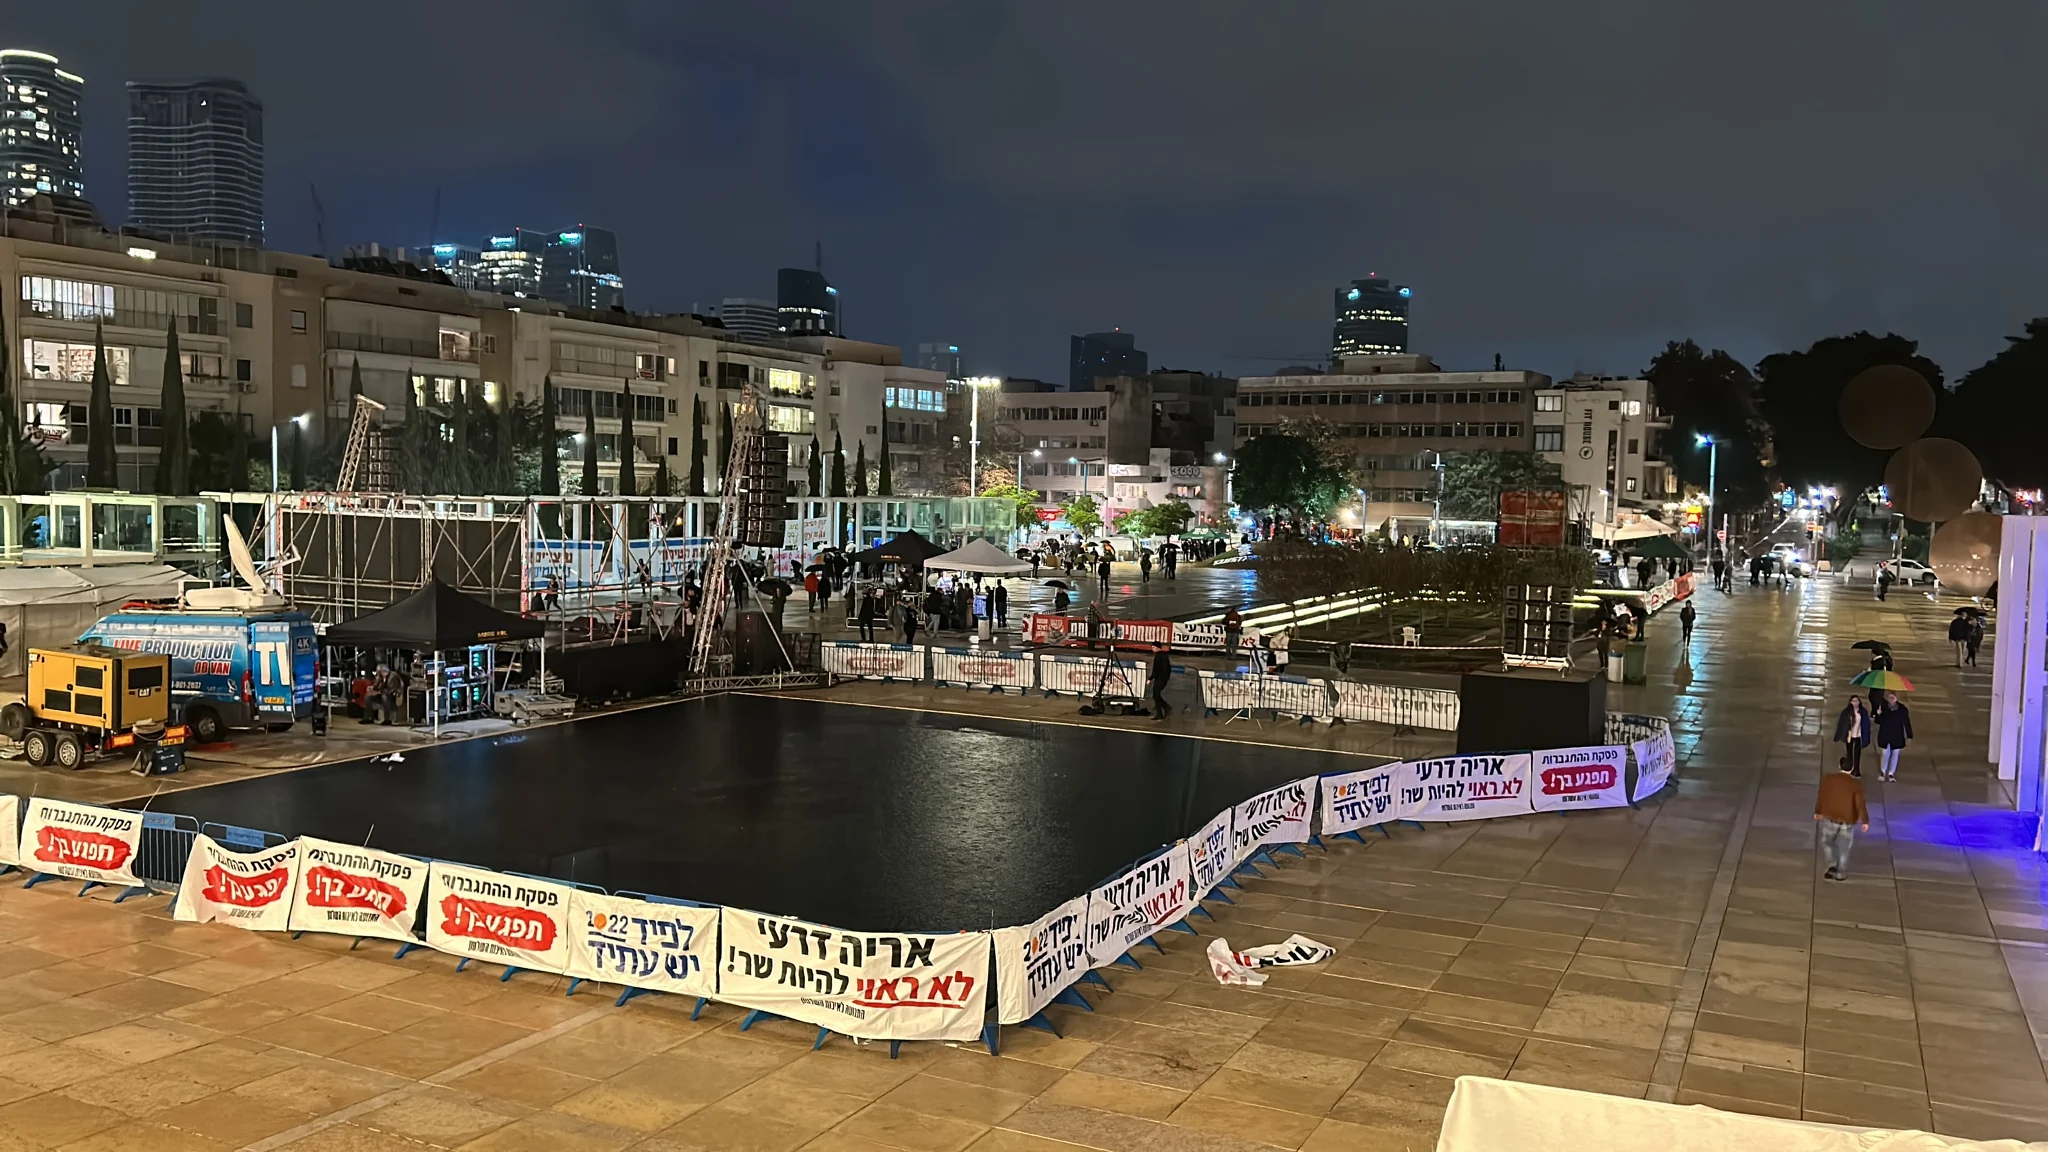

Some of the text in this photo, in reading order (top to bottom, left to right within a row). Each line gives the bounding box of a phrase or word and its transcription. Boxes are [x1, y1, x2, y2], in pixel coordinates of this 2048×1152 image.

[1582, 409, 1592, 444] FIT HOUSE
[143, 639, 236, 660] PRODUCTION
[297, 638, 309, 649] 4K
[194, 660, 231, 676] OB VAN
[139, 687, 150, 697] CAT
[1416, 758, 1506, 781] אריה דרעי
[1542, 750, 1618, 765] פסקת ההתגברות
[1359, 773, 1390, 797] לפיד
[1401, 777, 1523, 805] לא ראוי להיות שר!
[1550, 770, 1609, 791] תפגע בך!
[1334, 794, 1392, 823] יש עתיד
[97, 816, 132, 832] פסקת
[47, 832, 114, 861] תפגע בך!
[251, 848, 297, 872] פסקת
[370, 859, 412, 880] פסקת
[1135, 857, 1170, 899] אריה
[241, 877, 282, 901] פגע
[315, 873, 345, 903] בך!
[515, 887, 559, 907] פסקת
[1169, 878, 1185, 908] לא
[1144, 892, 1168, 920] ראוי
[485, 914, 543, 942] תפגע
[631, 917, 694, 951] לפיד
[1089, 916, 1110, 949] שר!
[757, 918, 936, 969] אריה דרעי
[587, 940, 701, 980] יש עתיד
[727, 945, 975, 1002] לא ראוי להיות שר!
[1027, 943, 1084, 998] יש עתיד
